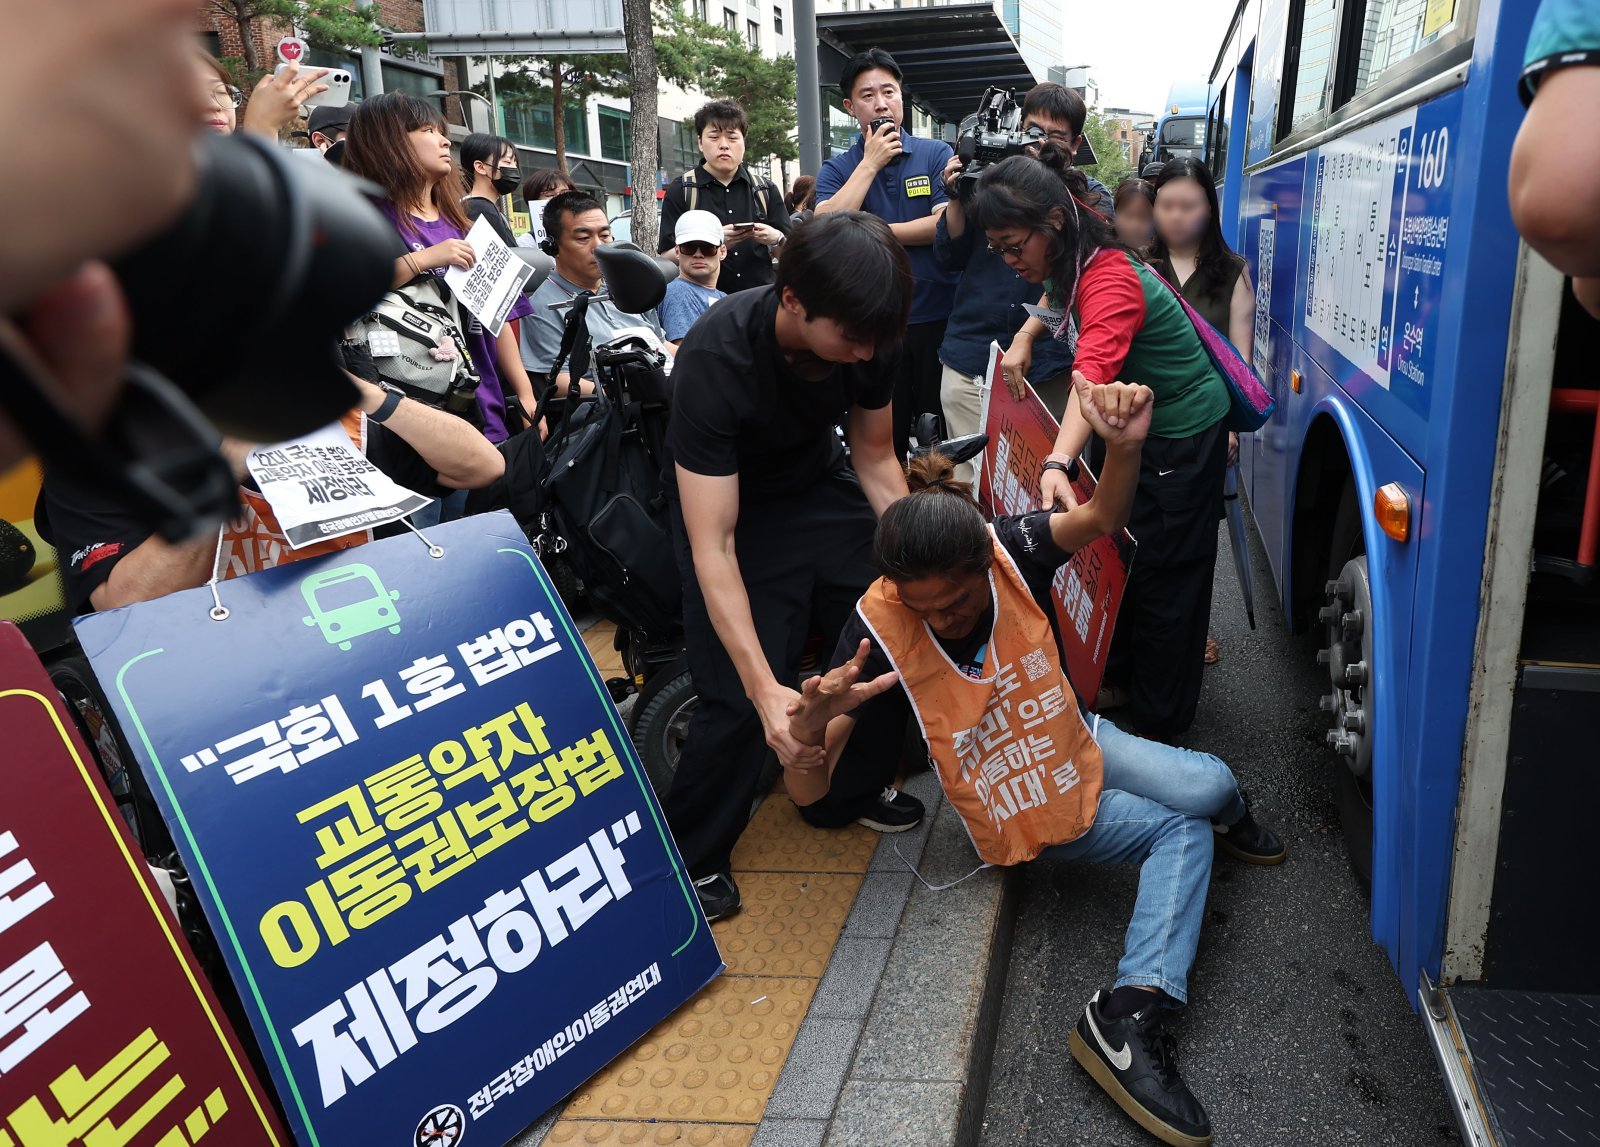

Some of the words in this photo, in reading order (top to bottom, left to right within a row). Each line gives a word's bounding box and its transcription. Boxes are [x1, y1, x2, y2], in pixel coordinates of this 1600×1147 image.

[909, 188, 930, 196] POLICE
[1417, 126, 1449, 190] 160
[481, 240, 501, 269] 기본권
[1380, 136, 1407, 361] 온수역
[1403, 321, 1424, 358] 온수역
[1408, 357, 1425, 388] Station
[361, 653, 464, 728] 1호
[461, 611, 563, 676] 법안
[296, 702, 550, 871] 교통약자
[974, 733, 1056, 807] 이동하는
[258, 728, 625, 970] 이동권보장법
[467, 961, 662, 1122] 전국장애인이동권연대
